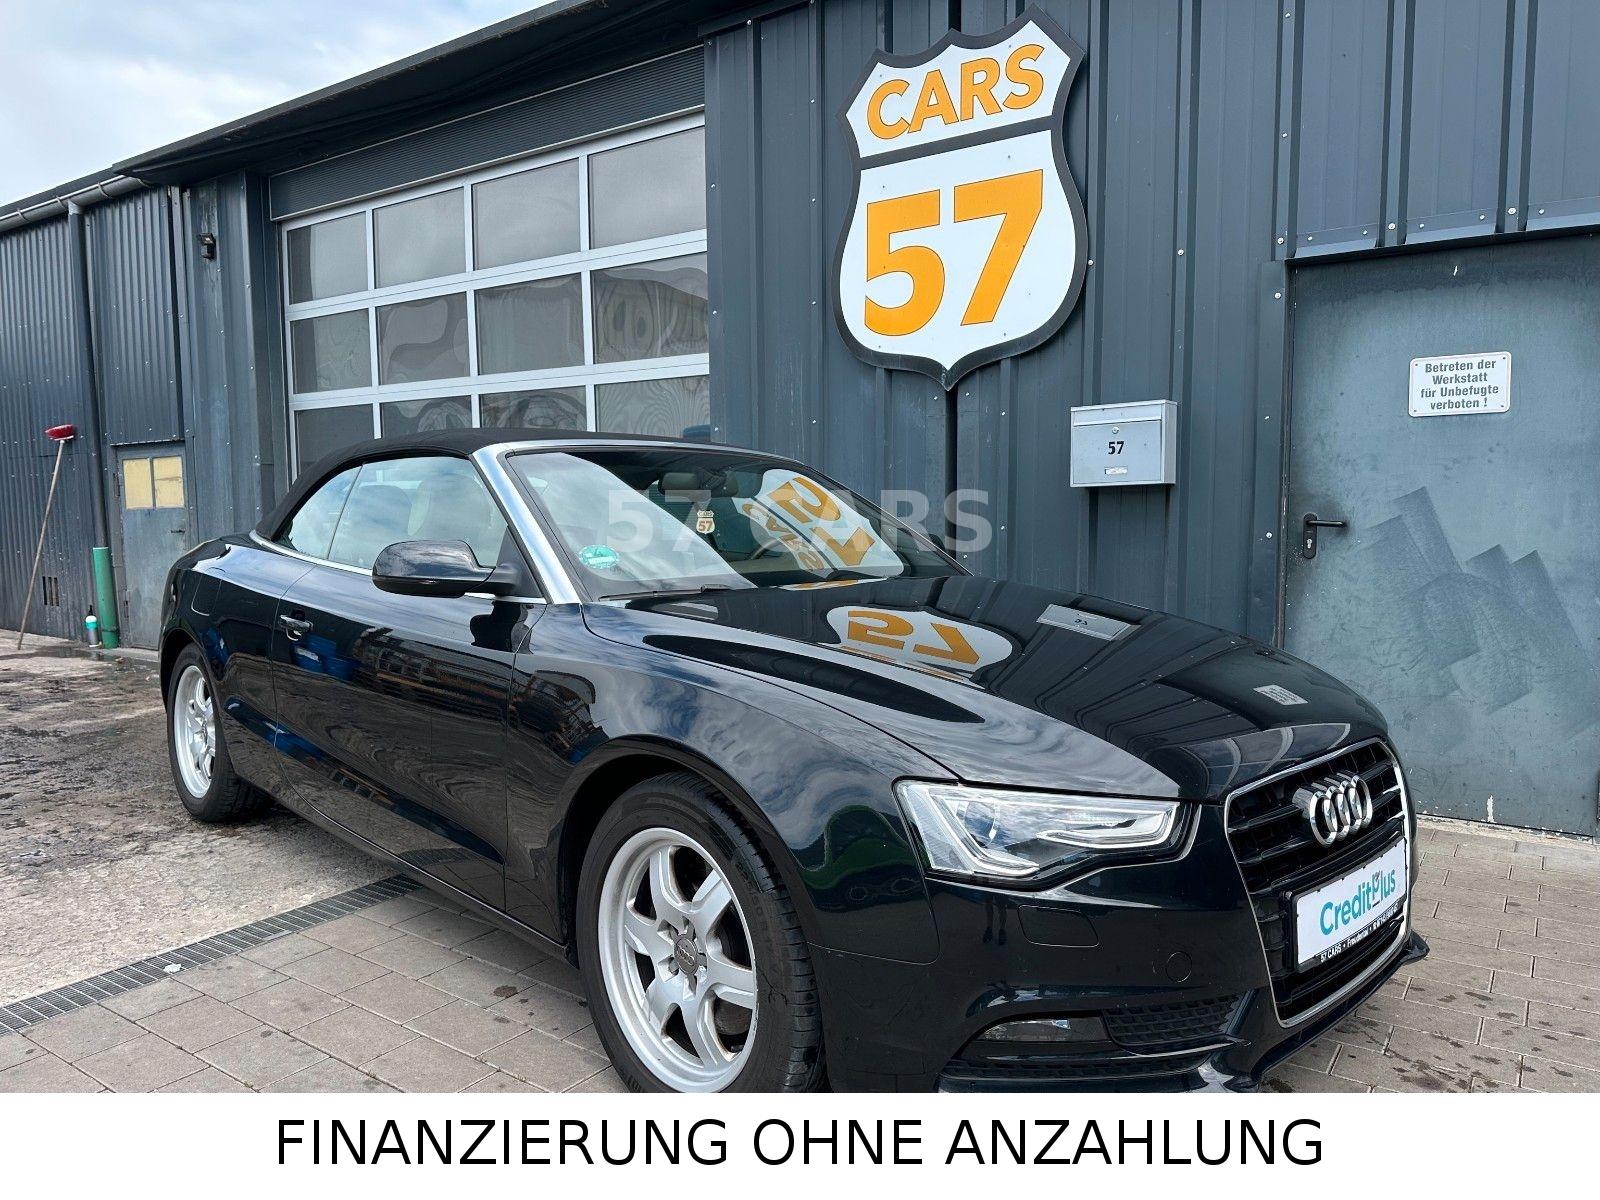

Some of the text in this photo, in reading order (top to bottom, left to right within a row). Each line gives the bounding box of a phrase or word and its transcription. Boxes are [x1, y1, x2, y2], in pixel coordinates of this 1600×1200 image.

[867, 44, 1045, 140] CARS
[864, 169, 1043, 336] 57
[1425, 359, 1496, 373] Betreten der
[1432, 372, 1488, 385] Werkstatt
[1420, 385, 1499, 398] für Unbefugte
[1430, 399, 1479, 410] verboten
[1108, 441, 1125, 455] 57
[698, 520, 713, 531] 57
[1320, 869, 1396, 936] CreditPlus
